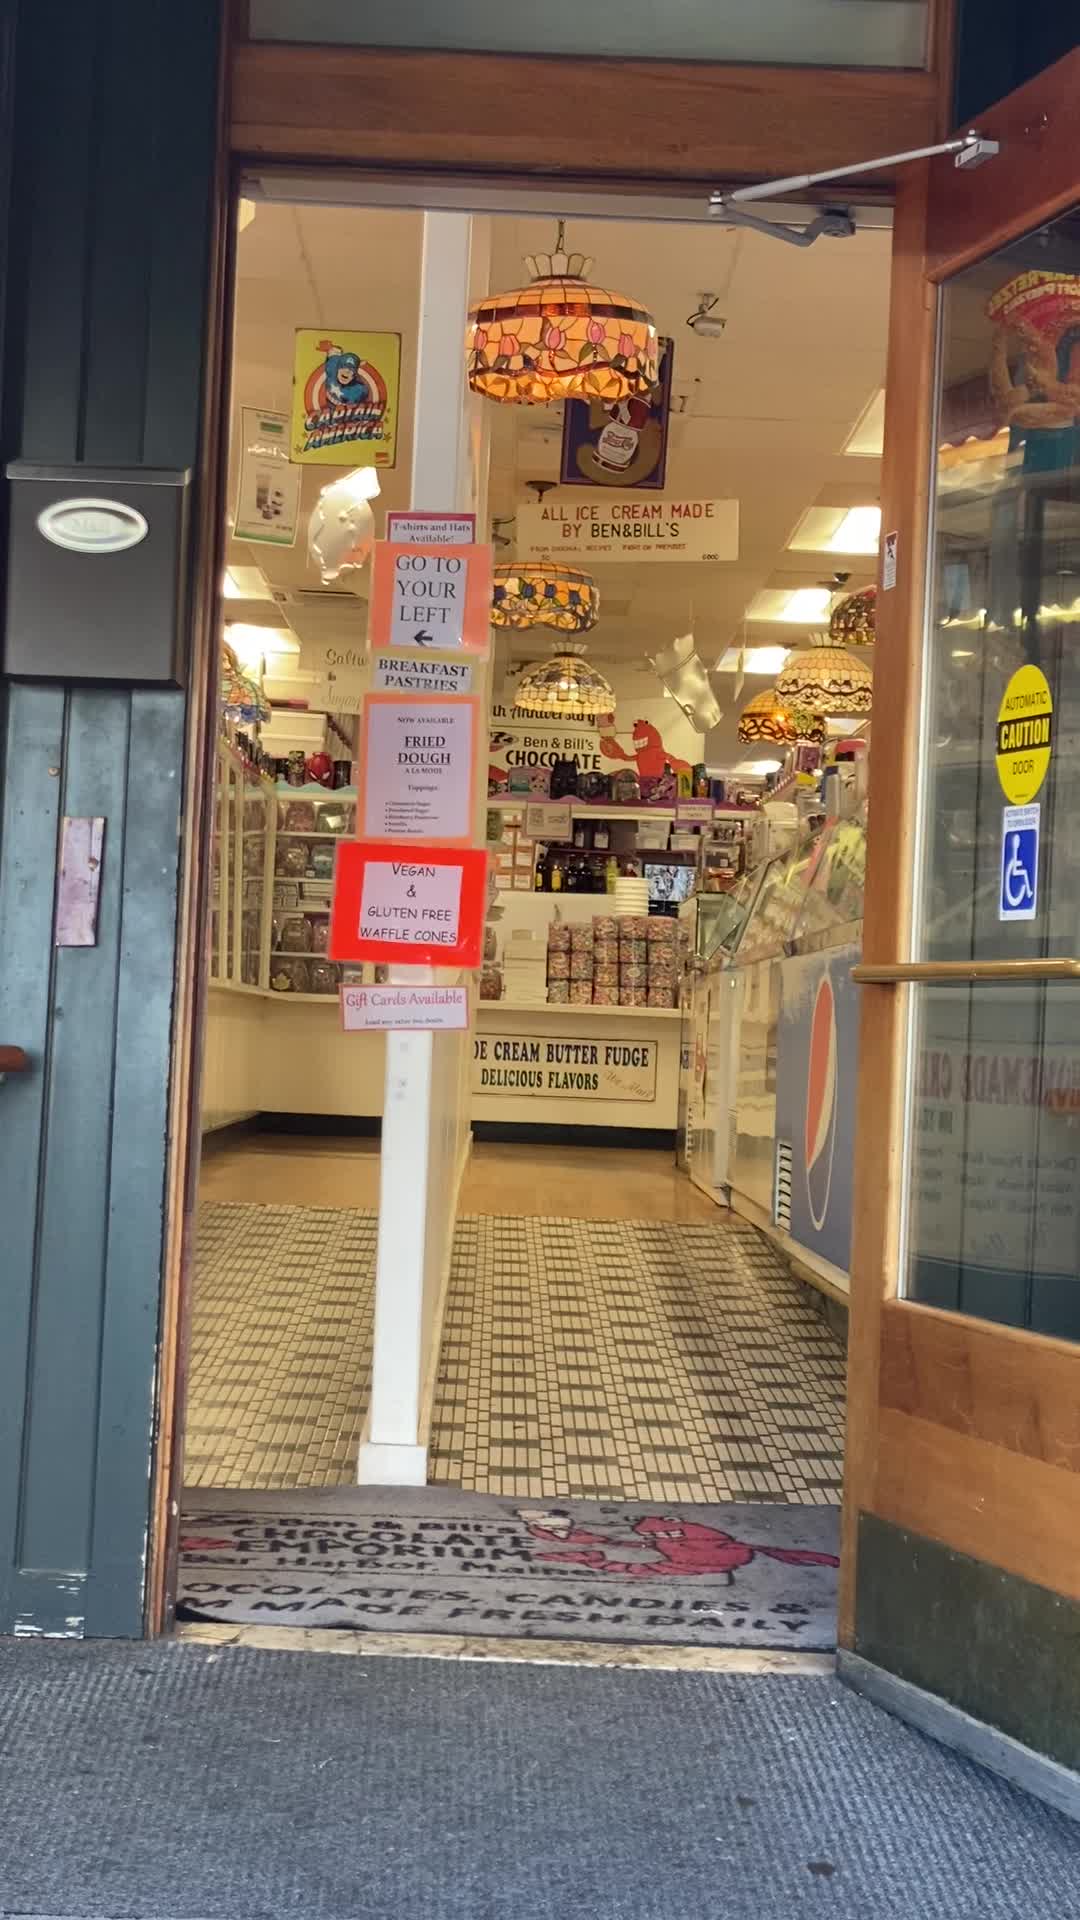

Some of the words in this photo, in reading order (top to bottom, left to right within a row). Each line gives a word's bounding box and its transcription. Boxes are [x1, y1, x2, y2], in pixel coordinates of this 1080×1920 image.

[304, 403, 384, 432] CAPTAIN
[303, 420, 384, 452] AMERICA
[541, 507, 568, 521] ALL
[576, 505, 600, 520] ICE
[611, 504, 663, 519] CREAM
[671, 503, 715, 518] MADE
[393, 522, 428, 532] T-shirts
[430, 523, 447, 531] and
[450, 523, 471, 532] Hats
[562, 523, 582, 538] BY
[591, 522, 680, 538] BEN&BILL'S
[396, 555, 427, 571] GO
[432, 556, 461, 573] TO
[397, 580, 456, 599] YOUR
[400, 606, 451, 624] LEFT
[379, 658, 469, 677] BREAKFAST
[385, 674, 458, 691] PASTRIES
[1005, 690, 1048, 711] AUTOMATIC
[405, 736, 446, 749] FRIED
[523, 736, 548, 748] Ben
[550, 737, 561, 749] &
[564, 738, 595, 751] Bill's
[1001, 718, 1050, 751] CAUTION
[398, 752, 451, 765] DOUGH
[1013, 760, 1034, 775] DOOR
[392, 863, 436, 877] VEGAN
[406, 884, 417, 898] &
[367, 906, 418, 919] GLUTEN
[421, 909, 453, 921] FREE
[360, 927, 410, 941] WAFFLE
[414, 930, 457, 943] CONES
[346, 992, 368, 1011] Gift
[371, 991, 407, 1006] Cards
[409, 989, 463, 1005] Available
[494, 1041, 541, 1062] CREAM
[546, 1043, 599, 1065] BUTTER
[605, 1046, 649, 1067] FUDGE
[481, 1068, 543, 1088] DELICIOUS
[548, 1071, 599, 1090] FLAVORS
[279, 1518, 358, 1529] Ben
[372, 1520, 404, 1531] &
[232, 1527, 537, 1549] CHOCOLATE
[235, 1539, 534, 1562] EMPORIUM
[461, 1561, 601, 1575] Maine
[505, 1592, 752, 1613] CANDIES
[769, 1602, 810, 1616] &
[250, 1597, 430, 1617] MADE
[447, 1606, 632, 1625] FRESH
[645, 1614, 811, 1634] DAILY
